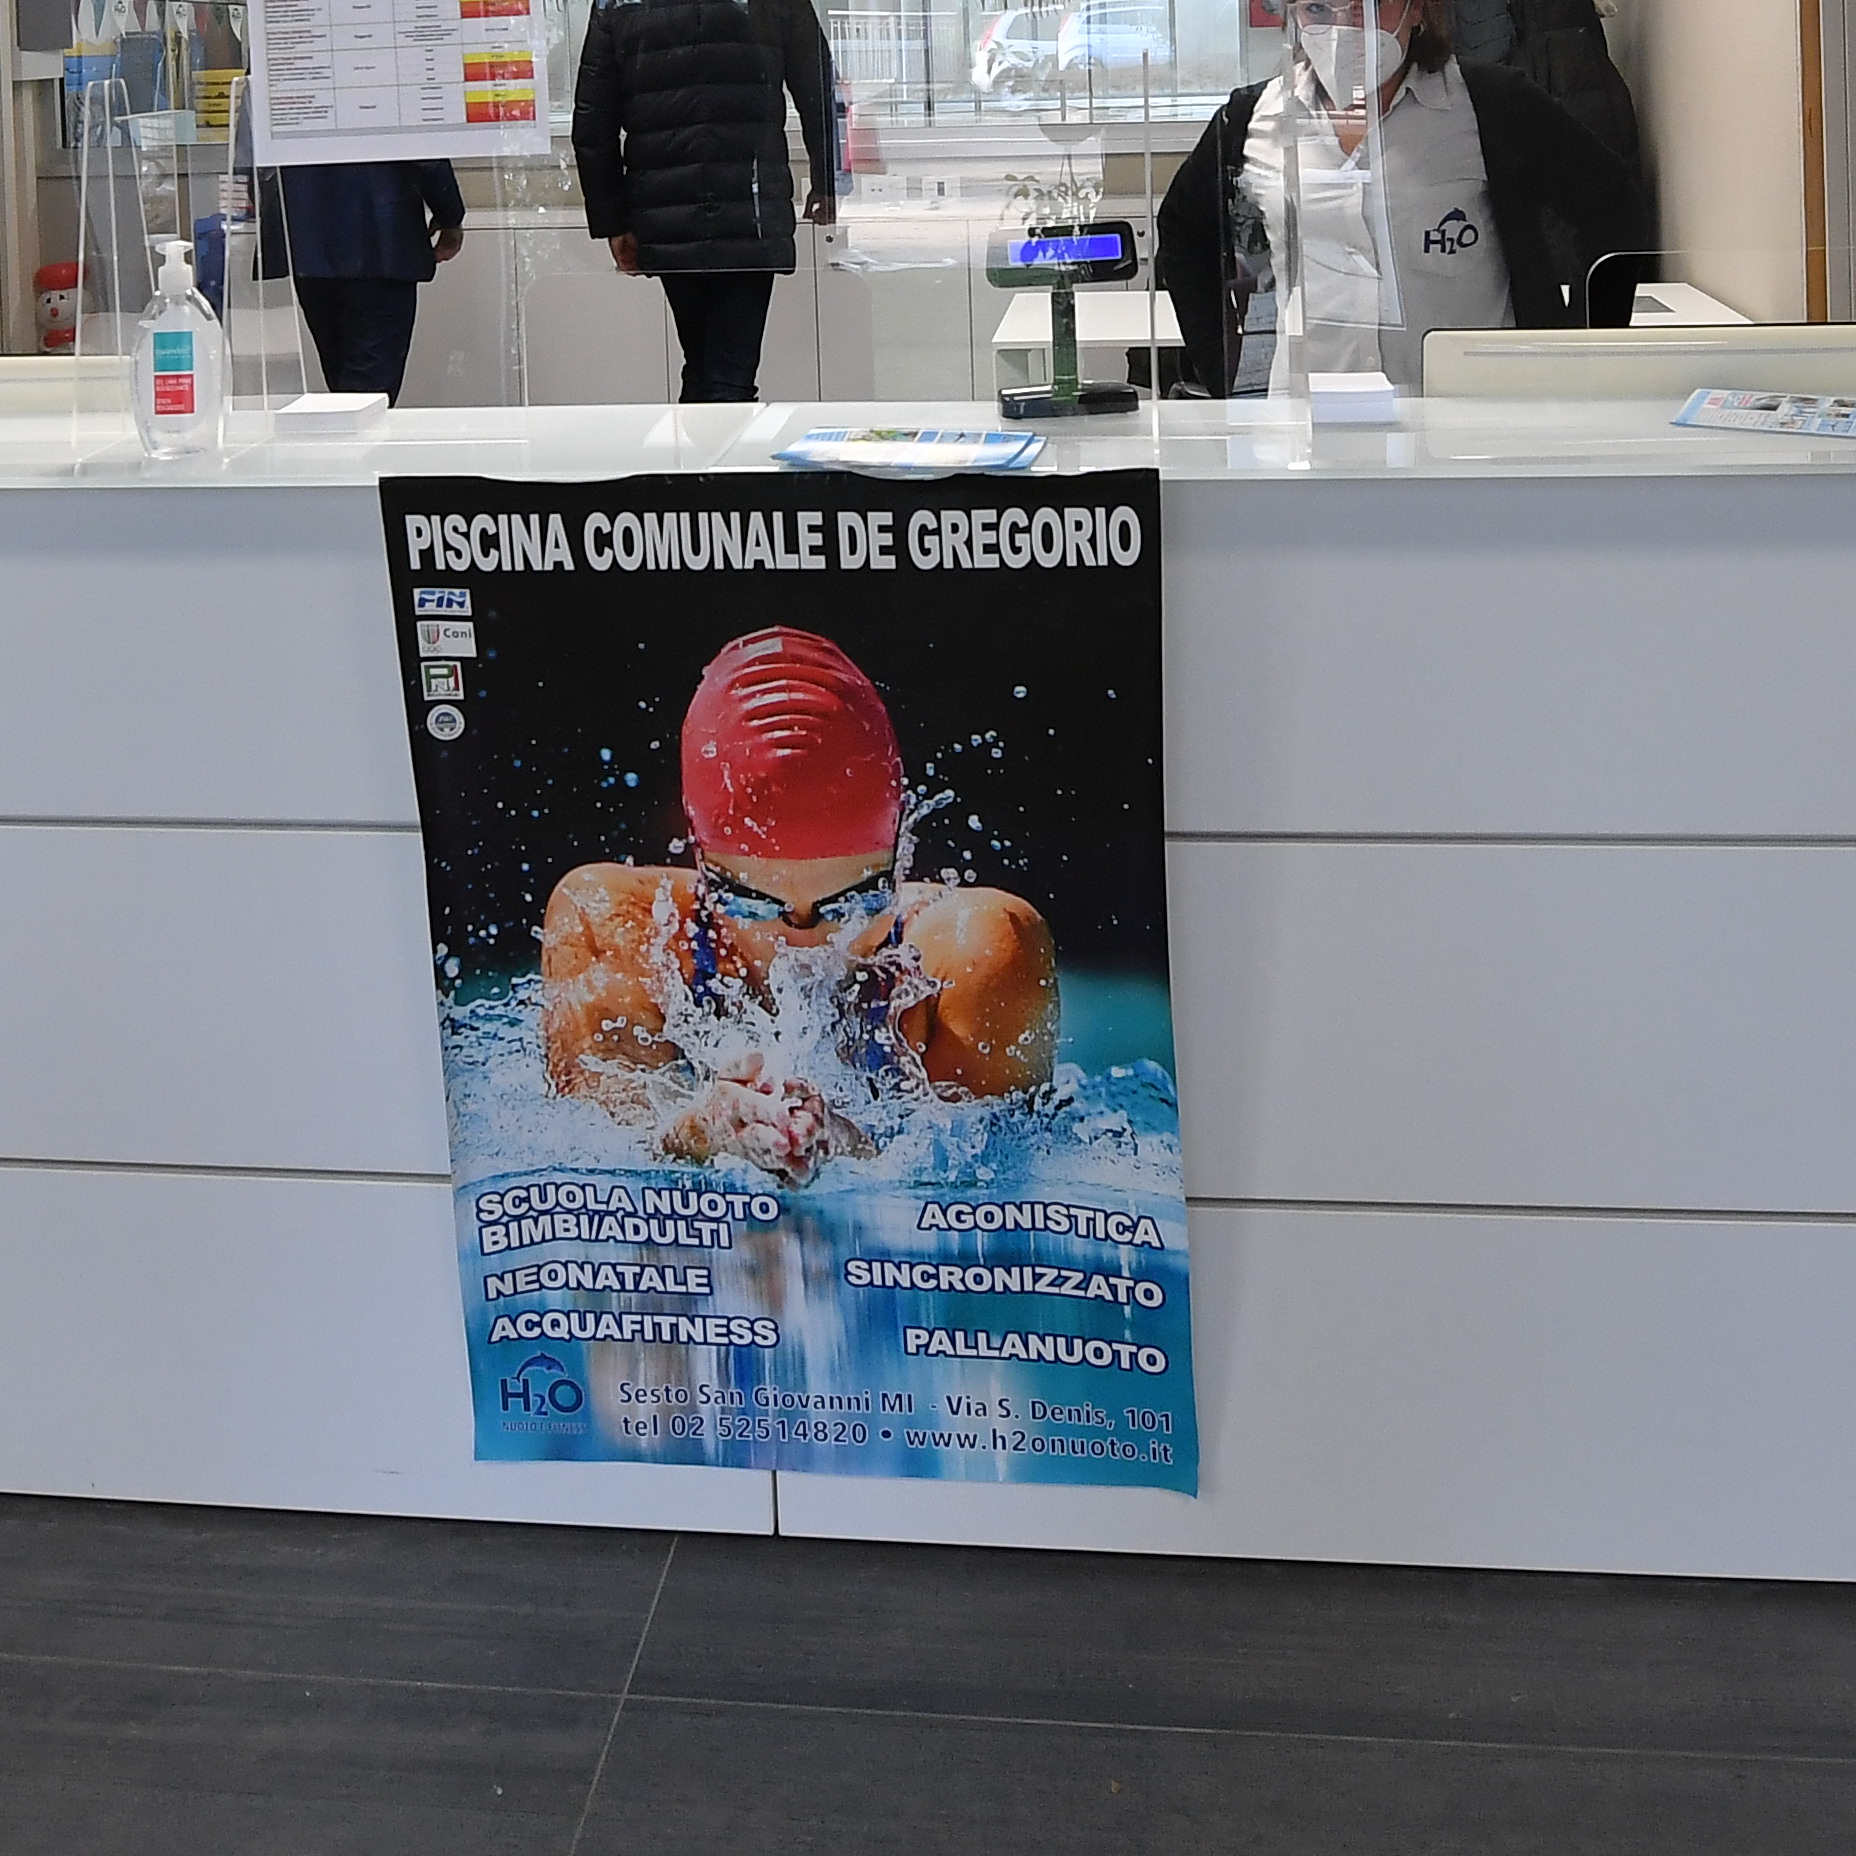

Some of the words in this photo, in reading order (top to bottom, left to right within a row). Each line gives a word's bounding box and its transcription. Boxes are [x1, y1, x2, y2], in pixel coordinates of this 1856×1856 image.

[1423, 224, 1479, 255] H2O
[405, 513, 575, 571] PISCINA
[583, 511, 826, 571] COMUNALE
[837, 511, 896, 570] DE
[907, 505, 1142, 570] GREGORIO
[477, 1184, 634, 1222] SCUOLA
[643, 1188, 780, 1222] NUOTO
[918, 1201, 1164, 1249] AGONISTICA
[481, 1212, 732, 1255] BIMBI/ADULTI
[485, 1261, 712, 1300] NEONATALE
[845, 1259, 1165, 1308] SINCRONIZZATO
[490, 1312, 780, 1346] ACQUAFITNESS
[905, 1326, 1168, 1374] PALLANUOTO
[500, 1378, 584, 1416] H2O
[619, 1382, 688, 1404] Sesto
[698, 1383, 743, 1406] San
[754, 1386, 871, 1412] Giovanni
[881, 1393, 913, 1414] MI
[945, 1395, 988, 1417] Via
[998, 1397, 1020, 1420] S.
[1031, 1400, 1116, 1430] Denis,
[1125, 1408, 1172, 1433] 101
[622, 1414, 659, 1437] tel
[671, 1415, 705, 1438] 02
[718, 1416, 867, 1444] 52514820
[905, 1428, 1173, 1464] www.h2onuoto.it
